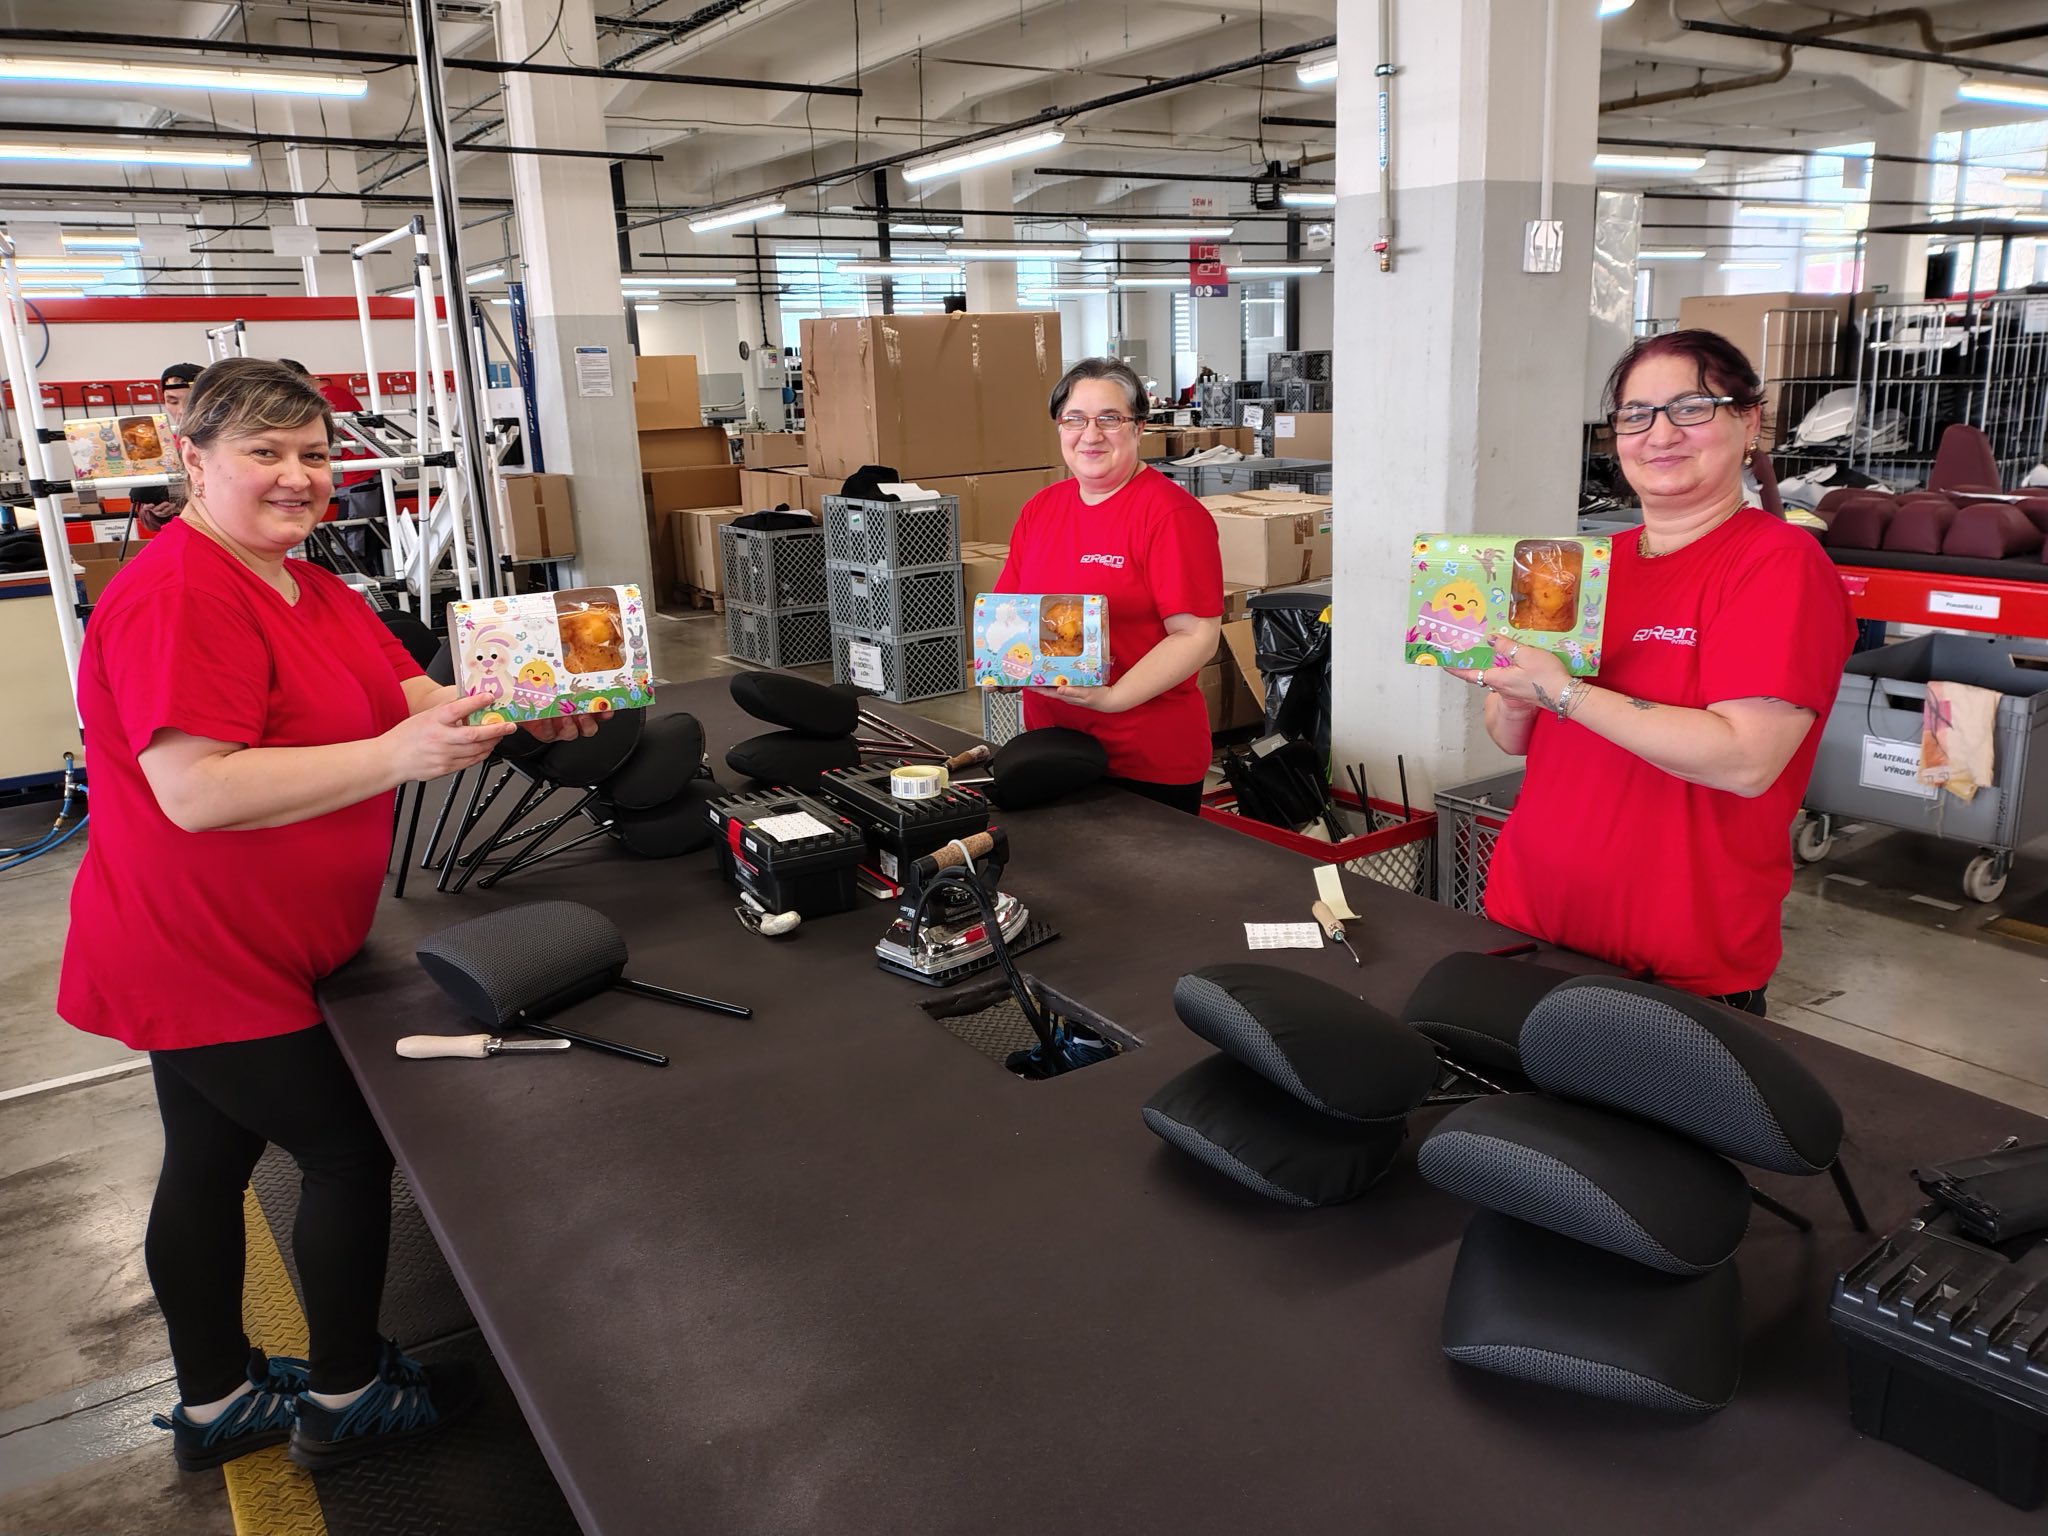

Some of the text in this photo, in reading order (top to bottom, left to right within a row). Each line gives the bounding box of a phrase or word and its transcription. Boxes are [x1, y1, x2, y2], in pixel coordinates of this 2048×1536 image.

[1192, 198, 1206, 207] SEW
[1873, 751, 1914, 766] MATERIAL
[1884, 765, 1917, 778] VÝROBY
